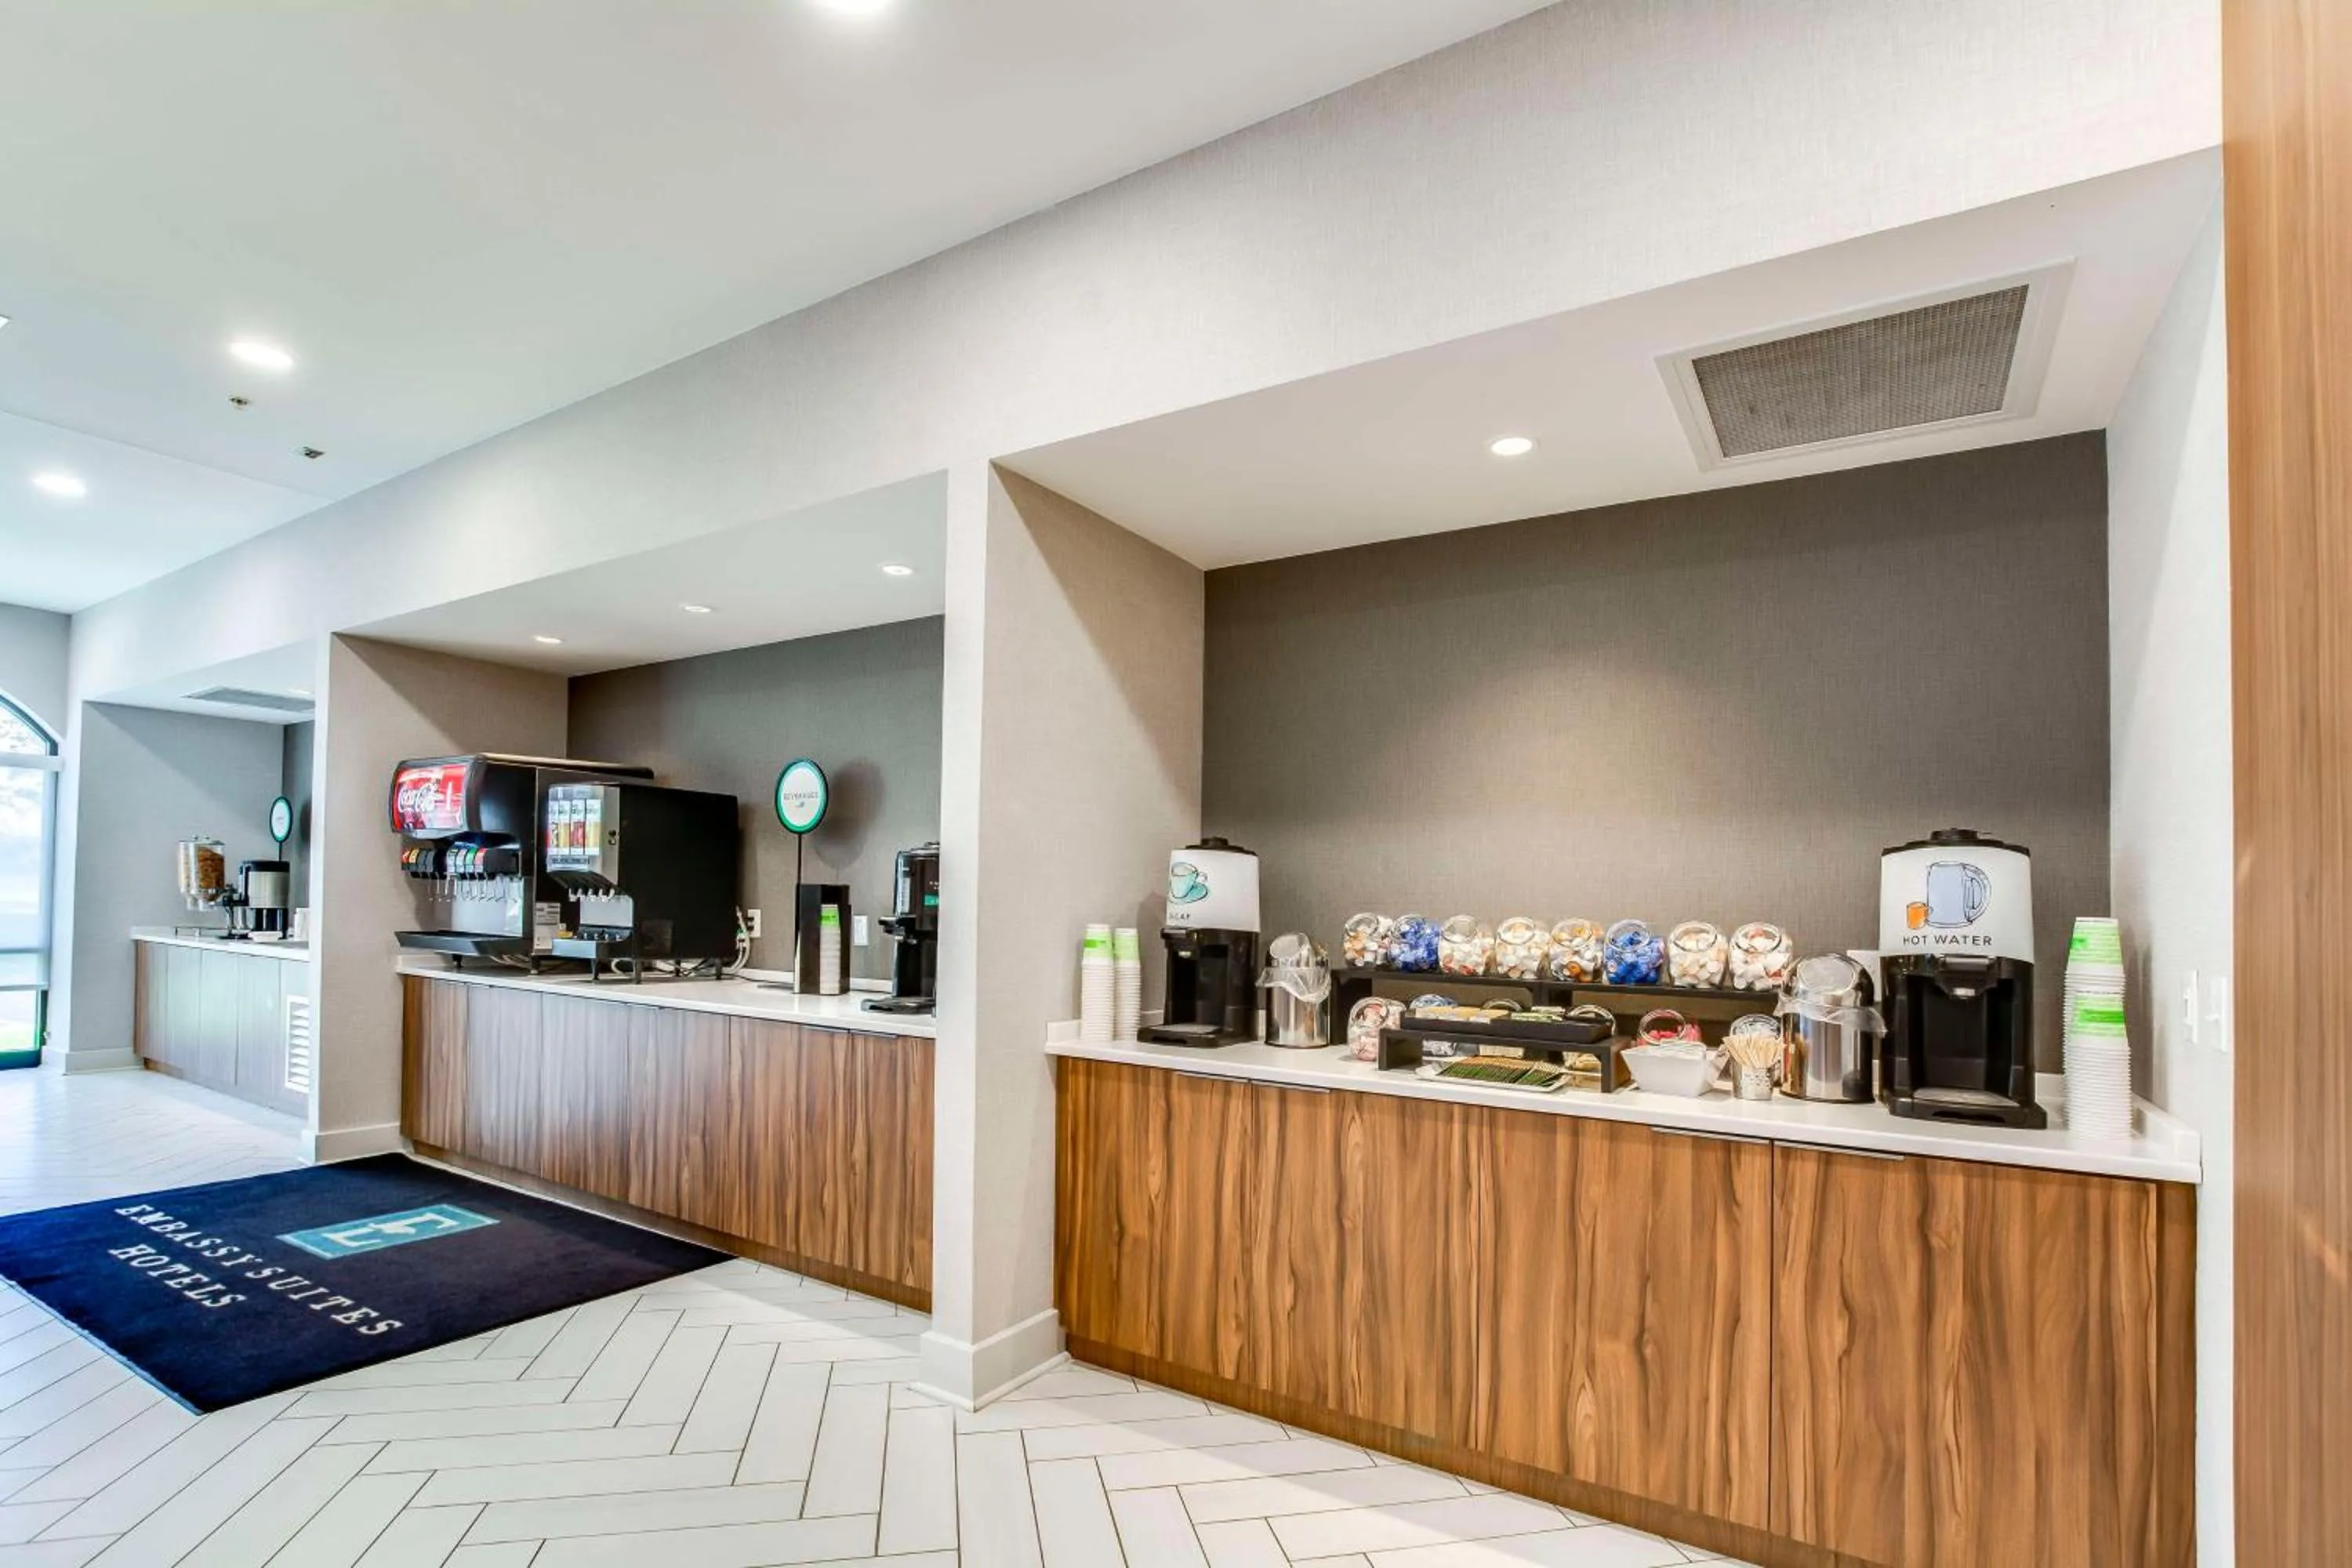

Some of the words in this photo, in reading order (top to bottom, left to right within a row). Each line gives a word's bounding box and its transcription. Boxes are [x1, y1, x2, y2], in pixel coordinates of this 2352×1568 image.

[1903, 935, 1928, 946] HOT
[1934, 935, 1992, 946] WATER
[107, 1243, 248, 1308] HOTELS
[114, 1203, 263, 1267] EMBASSY
[245, 1266, 404, 1335] SUITES
